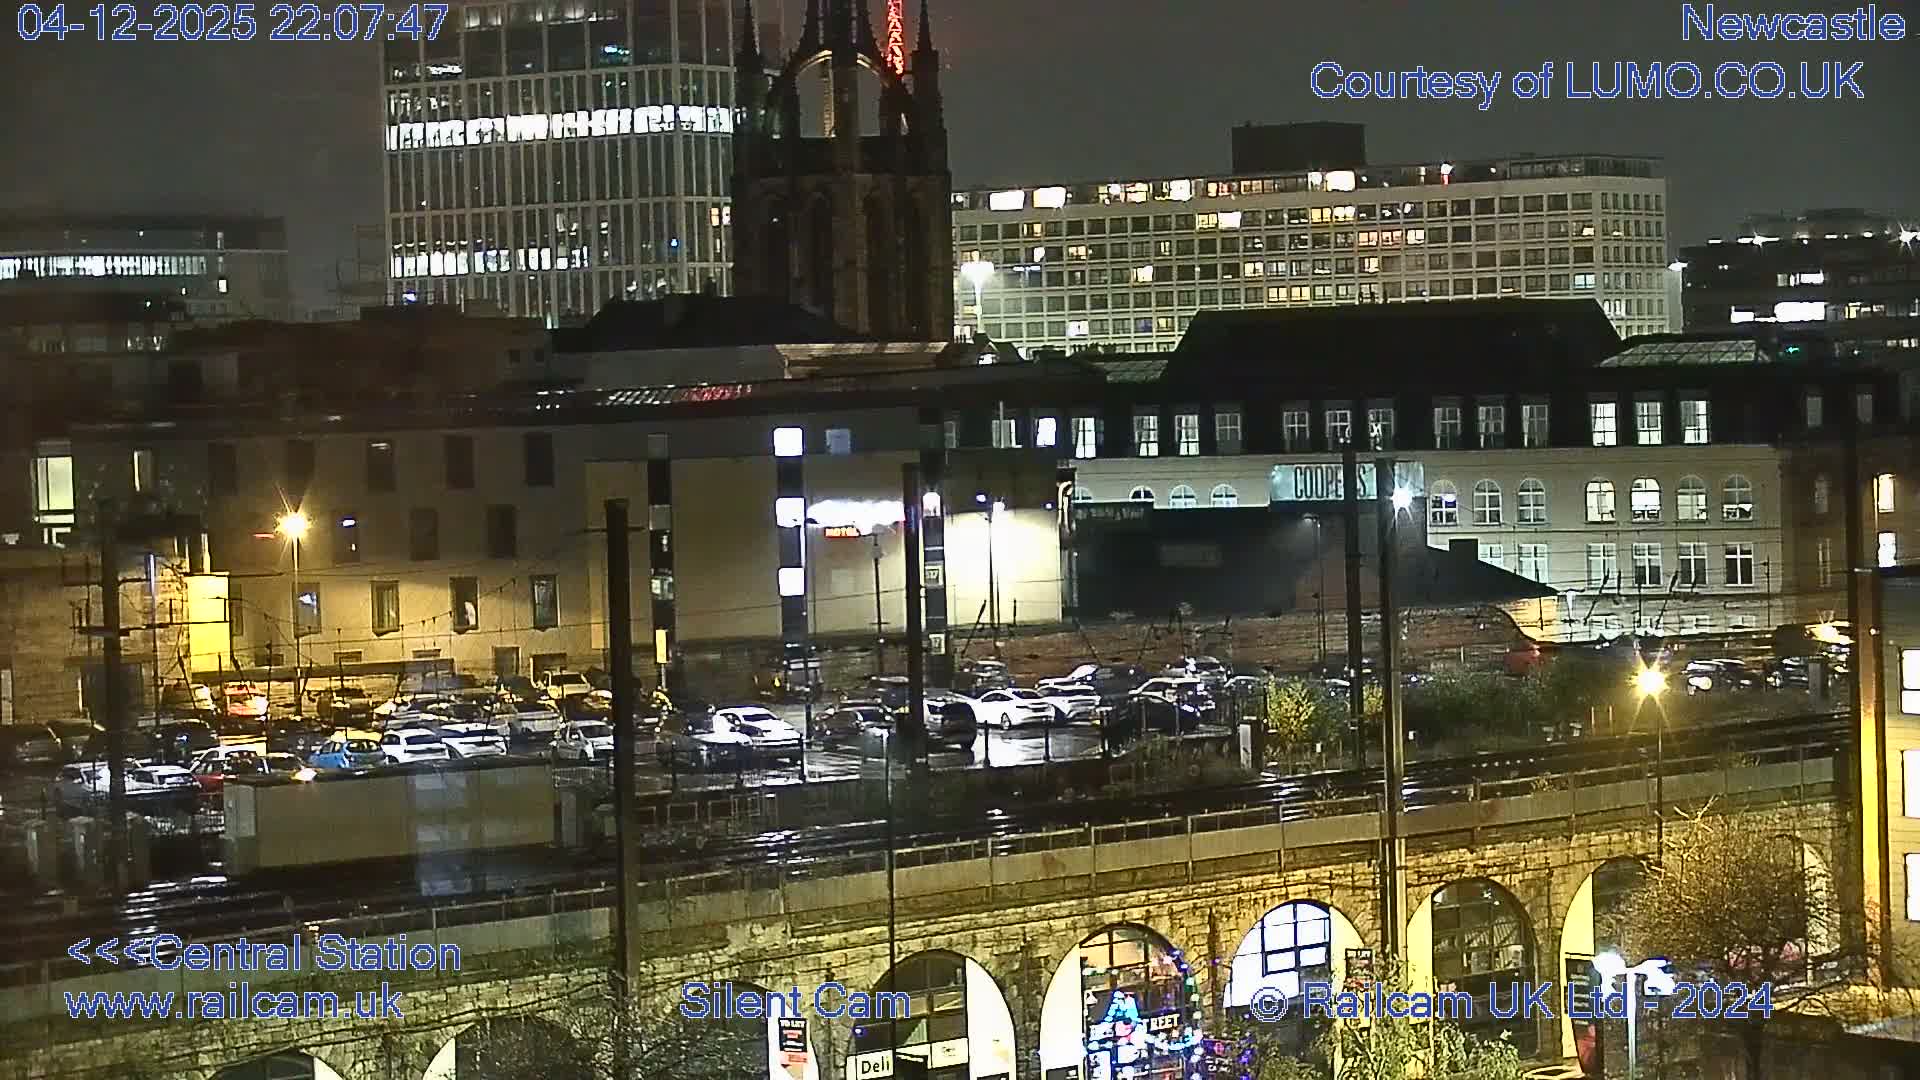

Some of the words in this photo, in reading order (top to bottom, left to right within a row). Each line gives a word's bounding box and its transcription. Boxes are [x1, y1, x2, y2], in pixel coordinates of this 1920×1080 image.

[1294, 465, 1367, 499] COOPES
[1136, 1013, 1181, 1033] TREET
[861, 1055, 890, 1075] Deli
